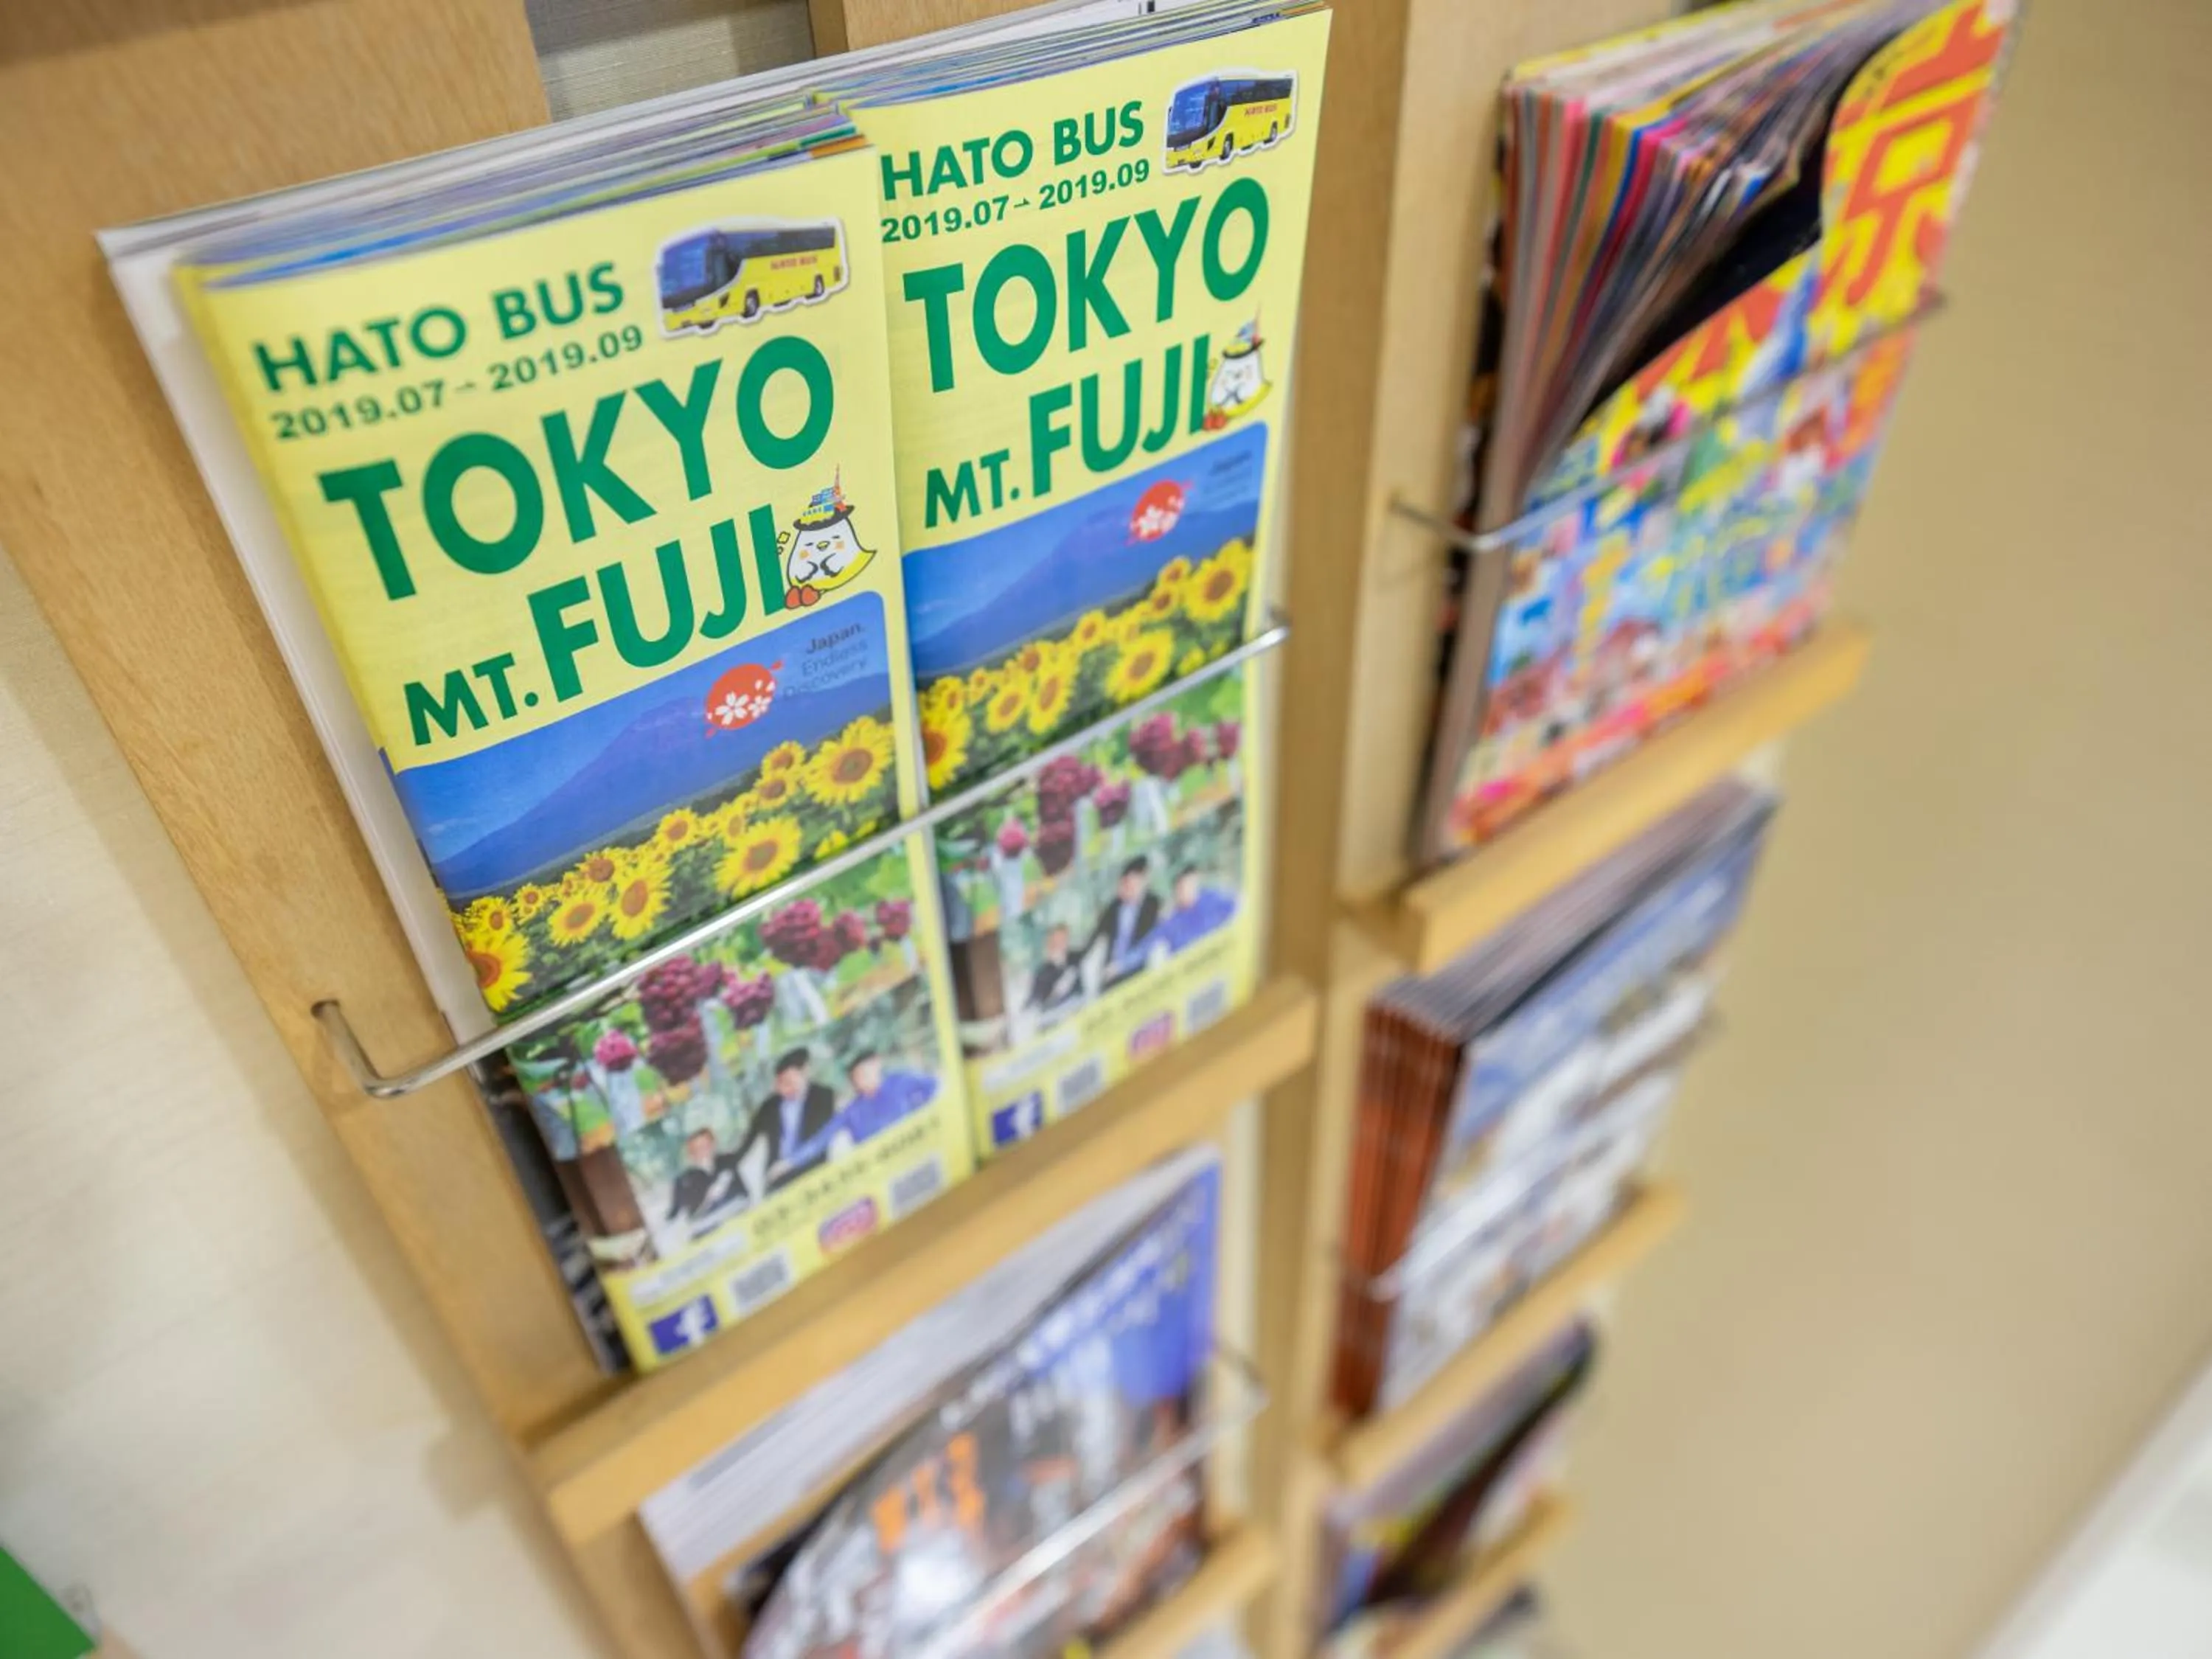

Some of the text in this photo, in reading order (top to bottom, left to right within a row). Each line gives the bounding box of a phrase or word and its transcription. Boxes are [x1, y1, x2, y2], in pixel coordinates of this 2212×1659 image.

[881, 100, 1144, 201] HATO BUS
[881, 159, 1150, 243] 2019.07 2019.09
[254, 262, 624, 392] HATO BUS
[902, 178, 1269, 393] TOKYO
[270, 324, 643, 440] 2019.07 2019.09
[925, 335, 1211, 528] MT. FUJI
[319, 335, 834, 600] TOKYO
[404, 504, 786, 746] MT. FUJI
